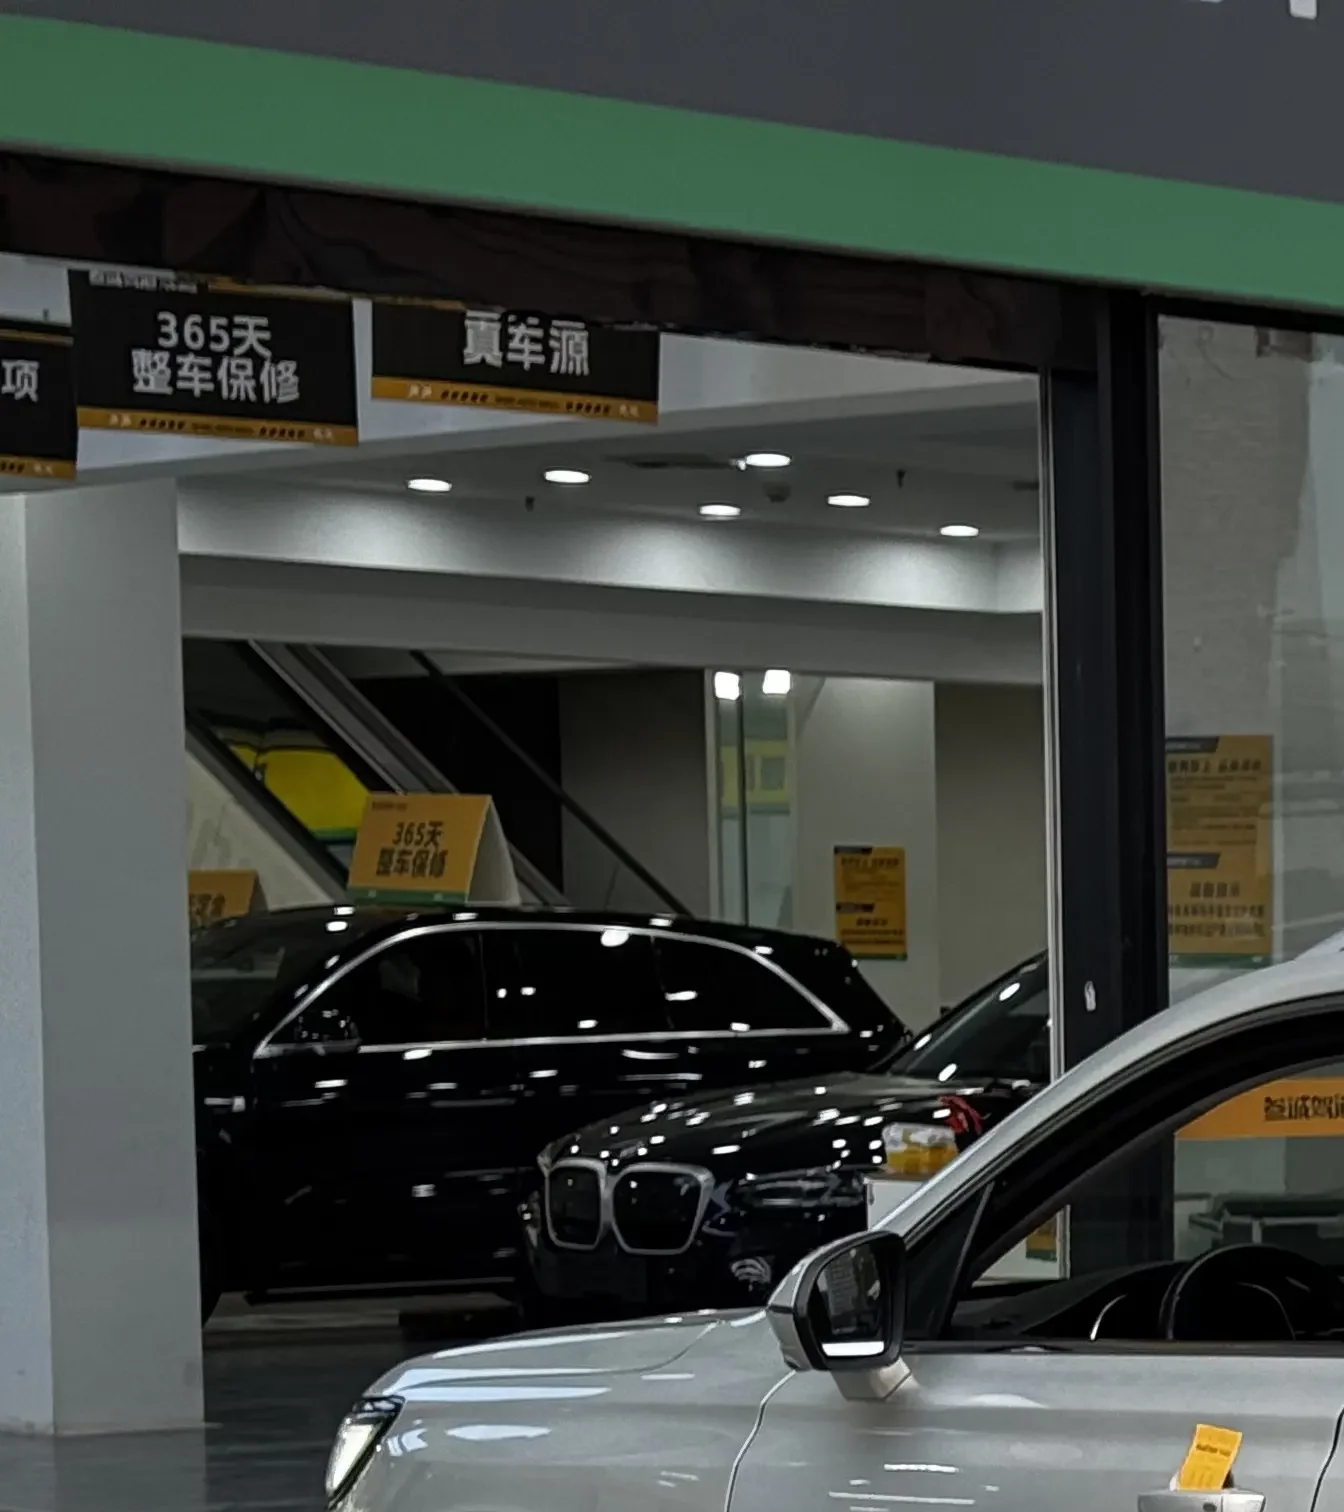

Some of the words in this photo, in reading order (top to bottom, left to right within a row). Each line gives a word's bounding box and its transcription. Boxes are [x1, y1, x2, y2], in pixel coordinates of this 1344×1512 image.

[157, 311, 272, 358] 365天
[463, 309, 590, 377] 真车源
[1, 359, 40, 403] 项
[131, 349, 300, 404] 整车保修
[391, 820, 444, 850] 365天
